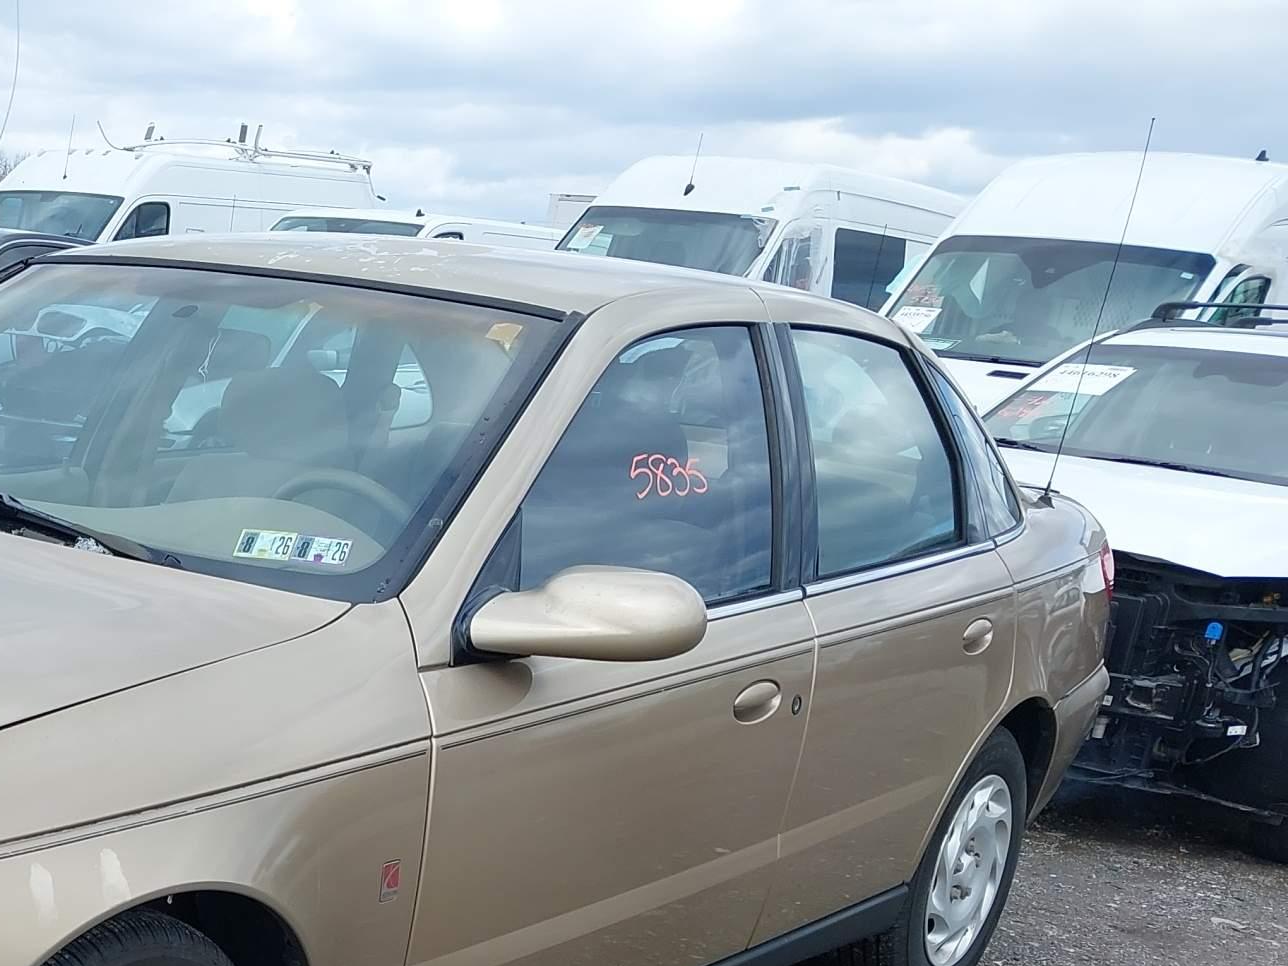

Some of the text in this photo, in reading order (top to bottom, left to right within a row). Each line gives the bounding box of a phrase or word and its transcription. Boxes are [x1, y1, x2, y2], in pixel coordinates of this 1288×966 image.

[630, 454, 708, 499] 5835
[274, 536, 293, 556] 26
[331, 541, 349, 562] 26
